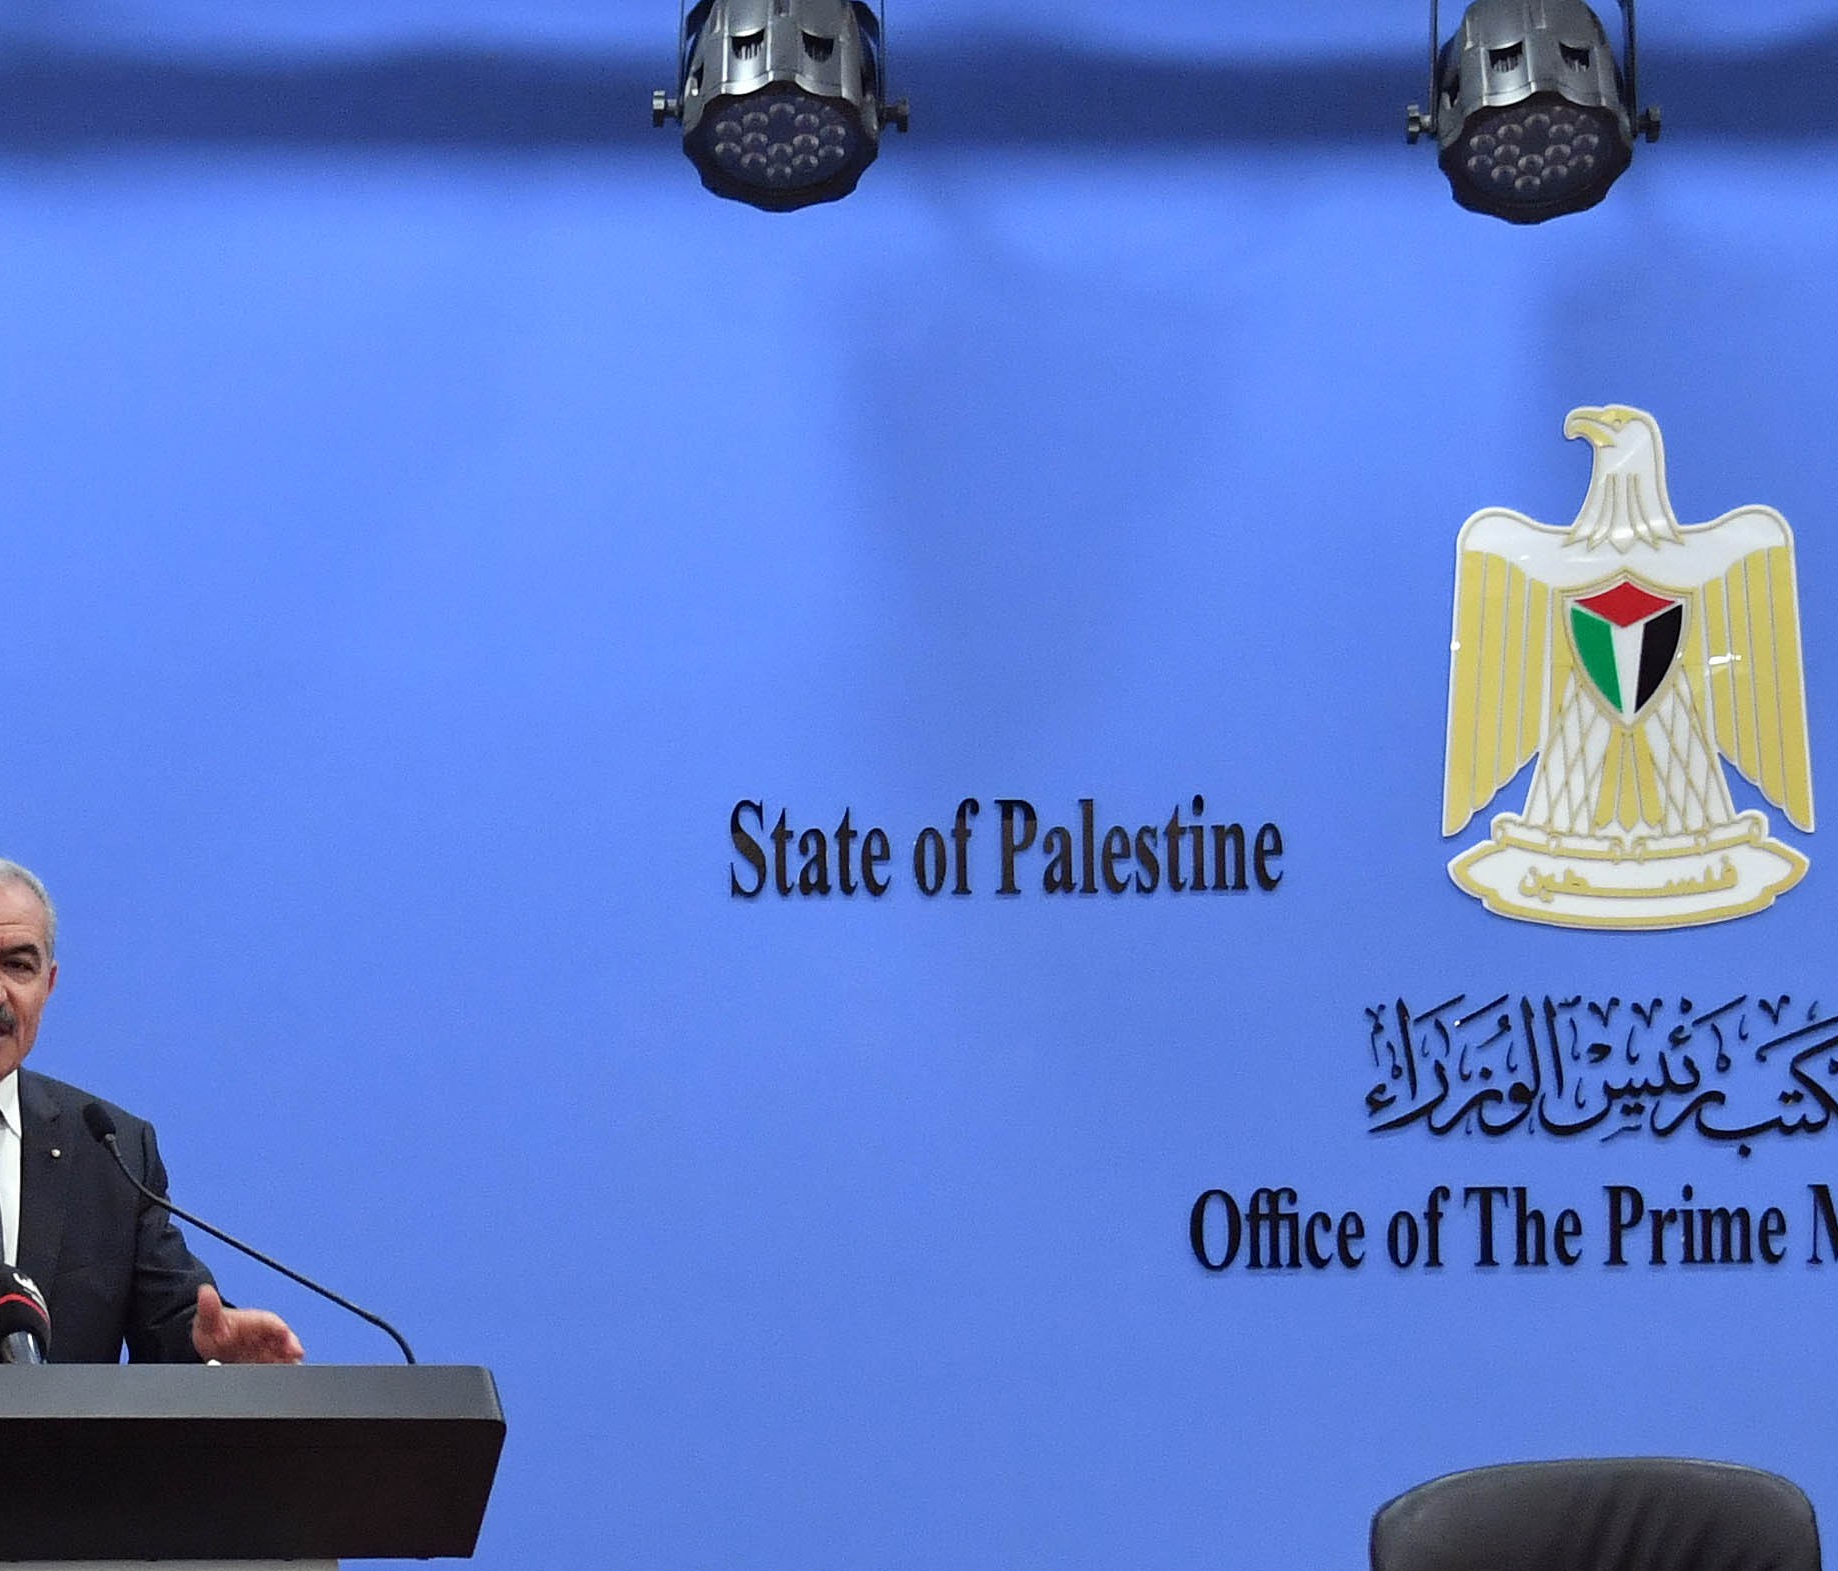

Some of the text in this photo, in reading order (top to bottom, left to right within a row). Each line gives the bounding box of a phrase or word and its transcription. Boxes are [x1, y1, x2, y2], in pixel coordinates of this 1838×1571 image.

[729, 793, 1286, 899] State of Palestine
[1364, 994, 1565, 1136] الوزراء
[1189, 1185, 1366, 1273] Office
[1386, 1185, 1451, 1269] of
[1463, 1185, 1583, 1268] The
[1601, 1183, 1788, 1267] Prime
